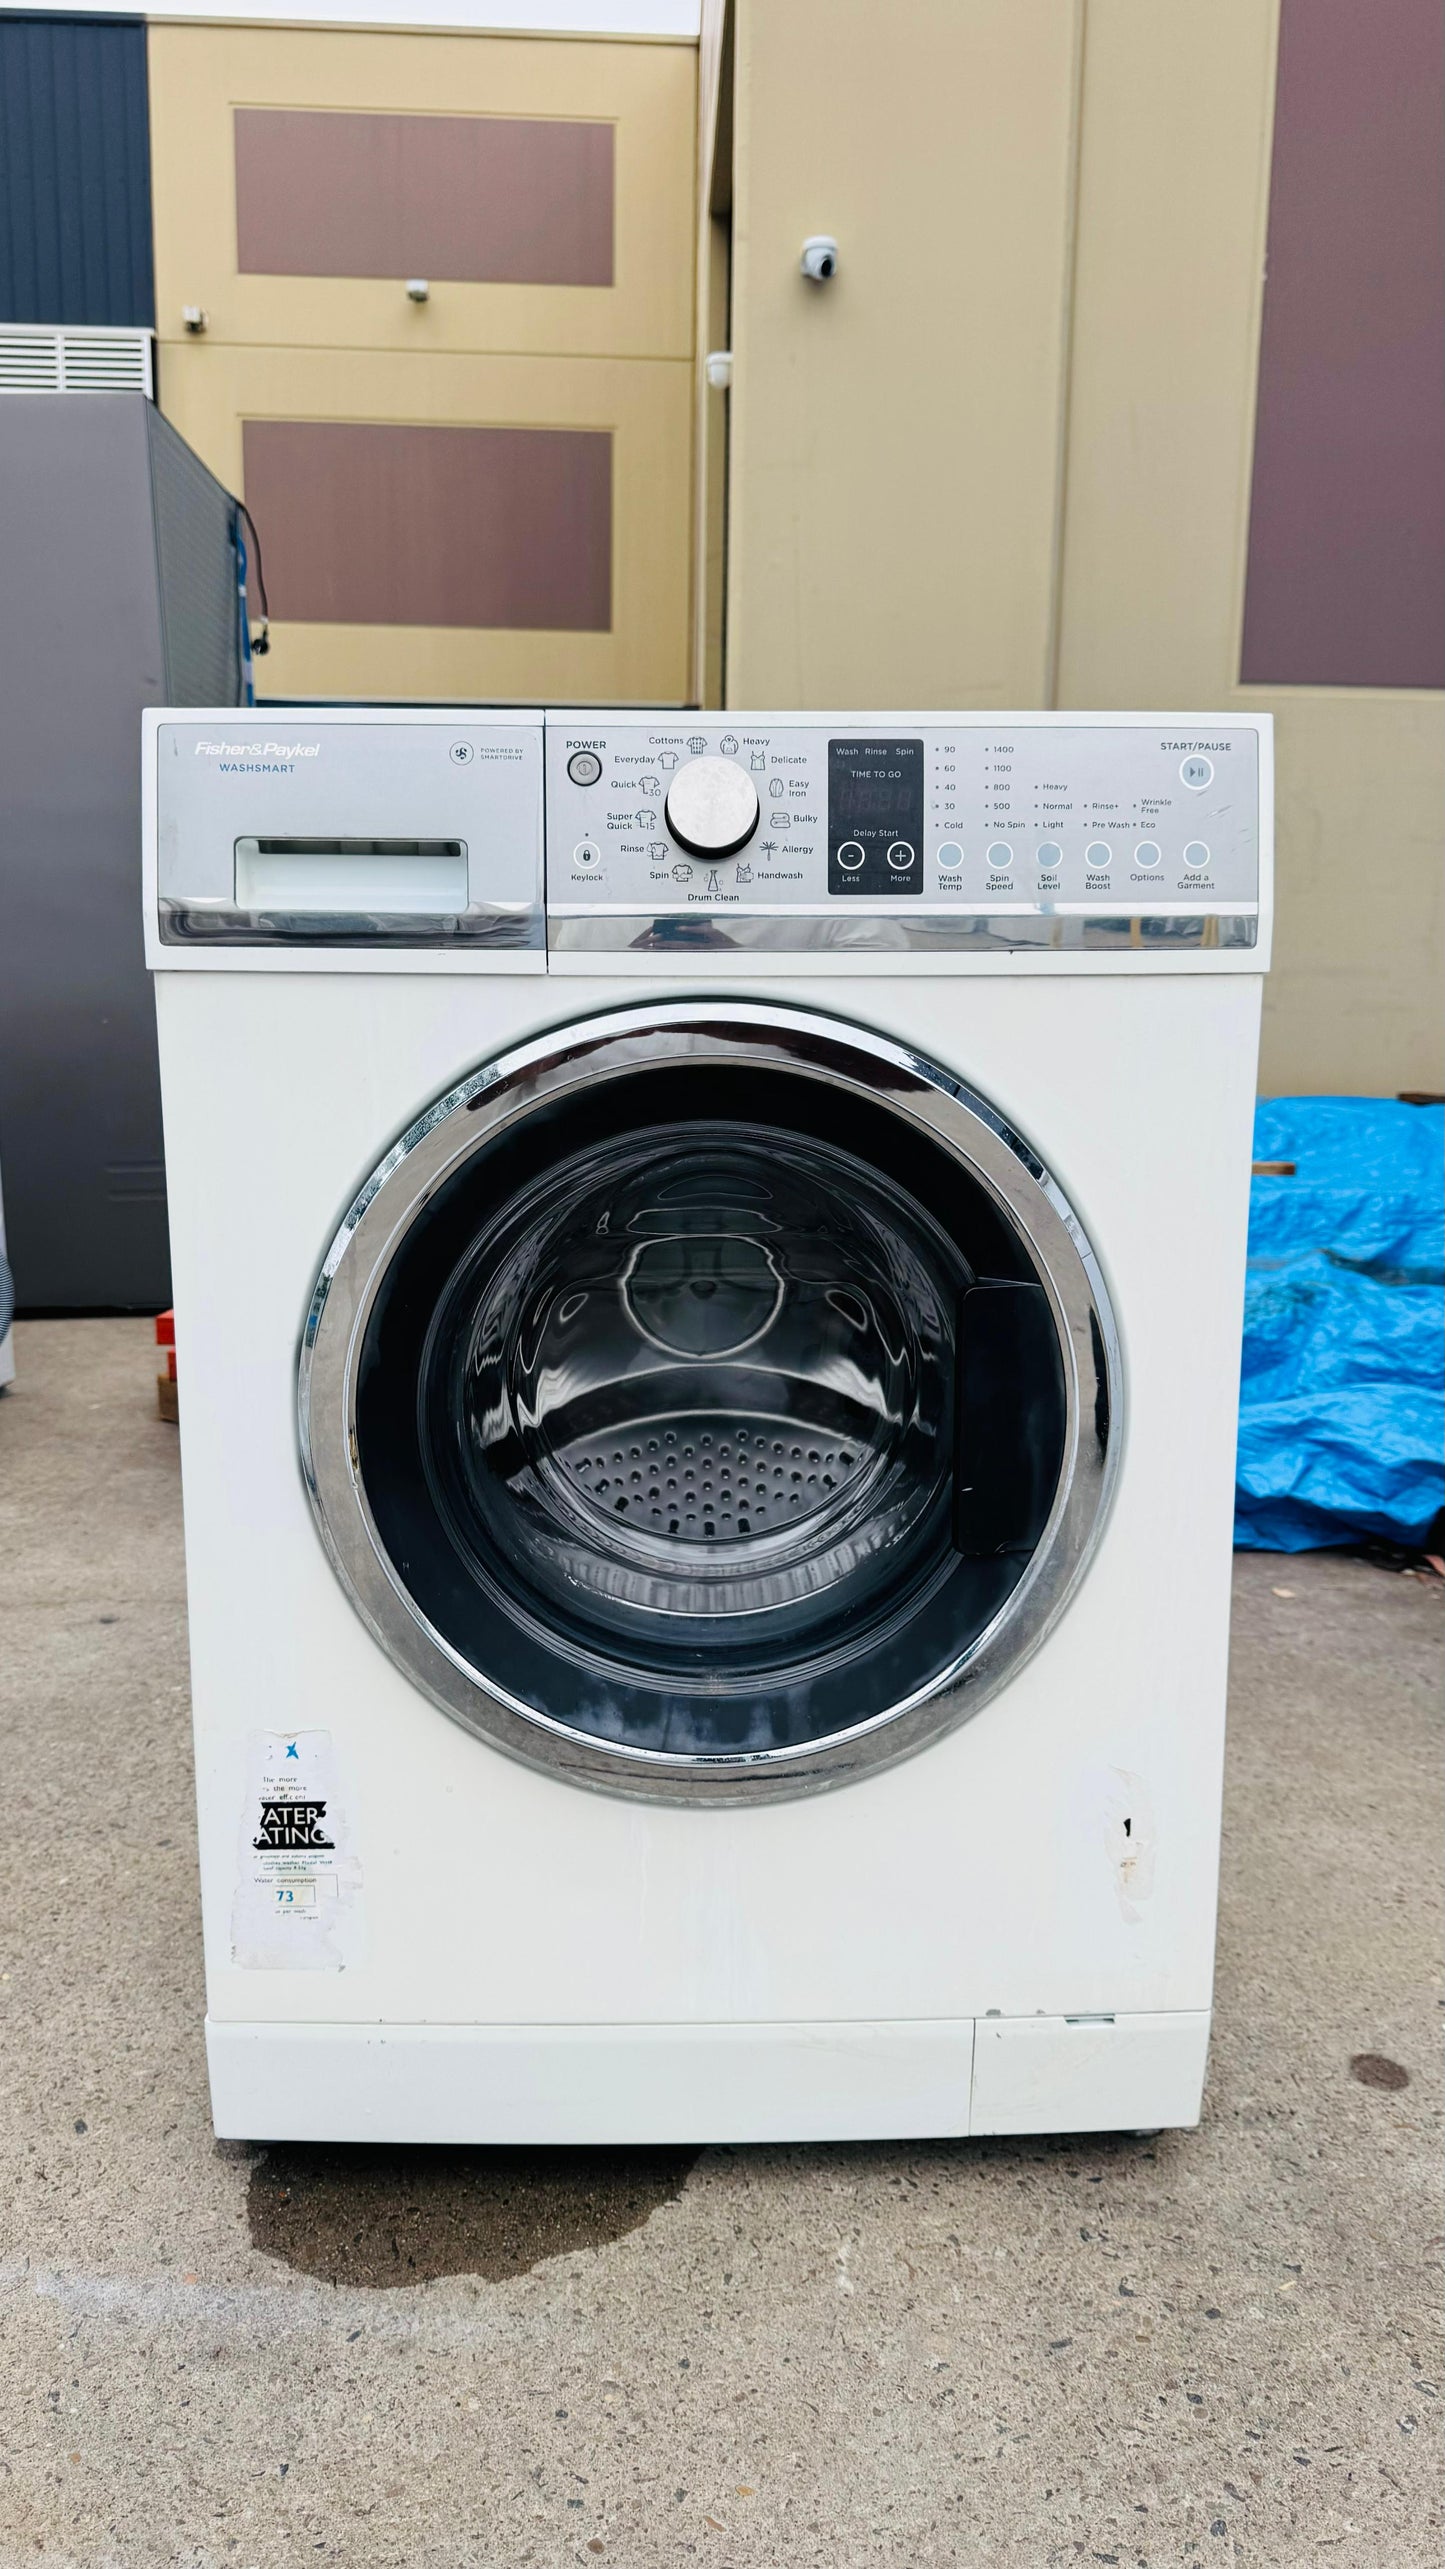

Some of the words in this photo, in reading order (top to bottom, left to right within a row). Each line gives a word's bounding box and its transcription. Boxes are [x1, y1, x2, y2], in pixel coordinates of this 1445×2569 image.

[566, 741, 606, 749] POWER
[649, 737, 683, 745] Cottons
[743, 737, 770, 746] Heavy
[195, 742, 320, 759] Fisher&Paykel
[1161, 742, 1231, 751] START/PAUSE
[896, 748, 914, 756] Spin
[614, 756, 655, 765] Everyday
[771, 756, 807, 764] Delicate
[220, 764, 295, 772] WASHSMART
[611, 780, 636, 789] Quick
[789, 780, 809, 789] Easy
[649, 788, 661, 796] 30
[607, 813, 632, 822] Super
[794, 814, 818, 824] Bulky
[607, 822, 632, 830] Quick
[645, 822, 655, 830] 15
[853, 830, 876, 838] Delay
[621, 845, 644, 853] Rinse
[782, 845, 813, 855] Allergy
[571, 874, 603, 882] Keylock
[650, 871, 669, 880] Spin
[758, 871, 803, 879] Handwash
[990, 875, 1009, 883] Spin
[1130, 874, 1164, 882] Options
[938, 883, 962, 891] Temp
[986, 883, 1013, 891] Speed
[1177, 882, 1215, 890] Garment
[688, 893, 712, 901] Drum
[715, 893, 739, 901] Clean
[261, 1807, 319, 1825] ATER
[254, 1827, 327, 1845] ATING
[276, 1890, 294, 1901] 73
